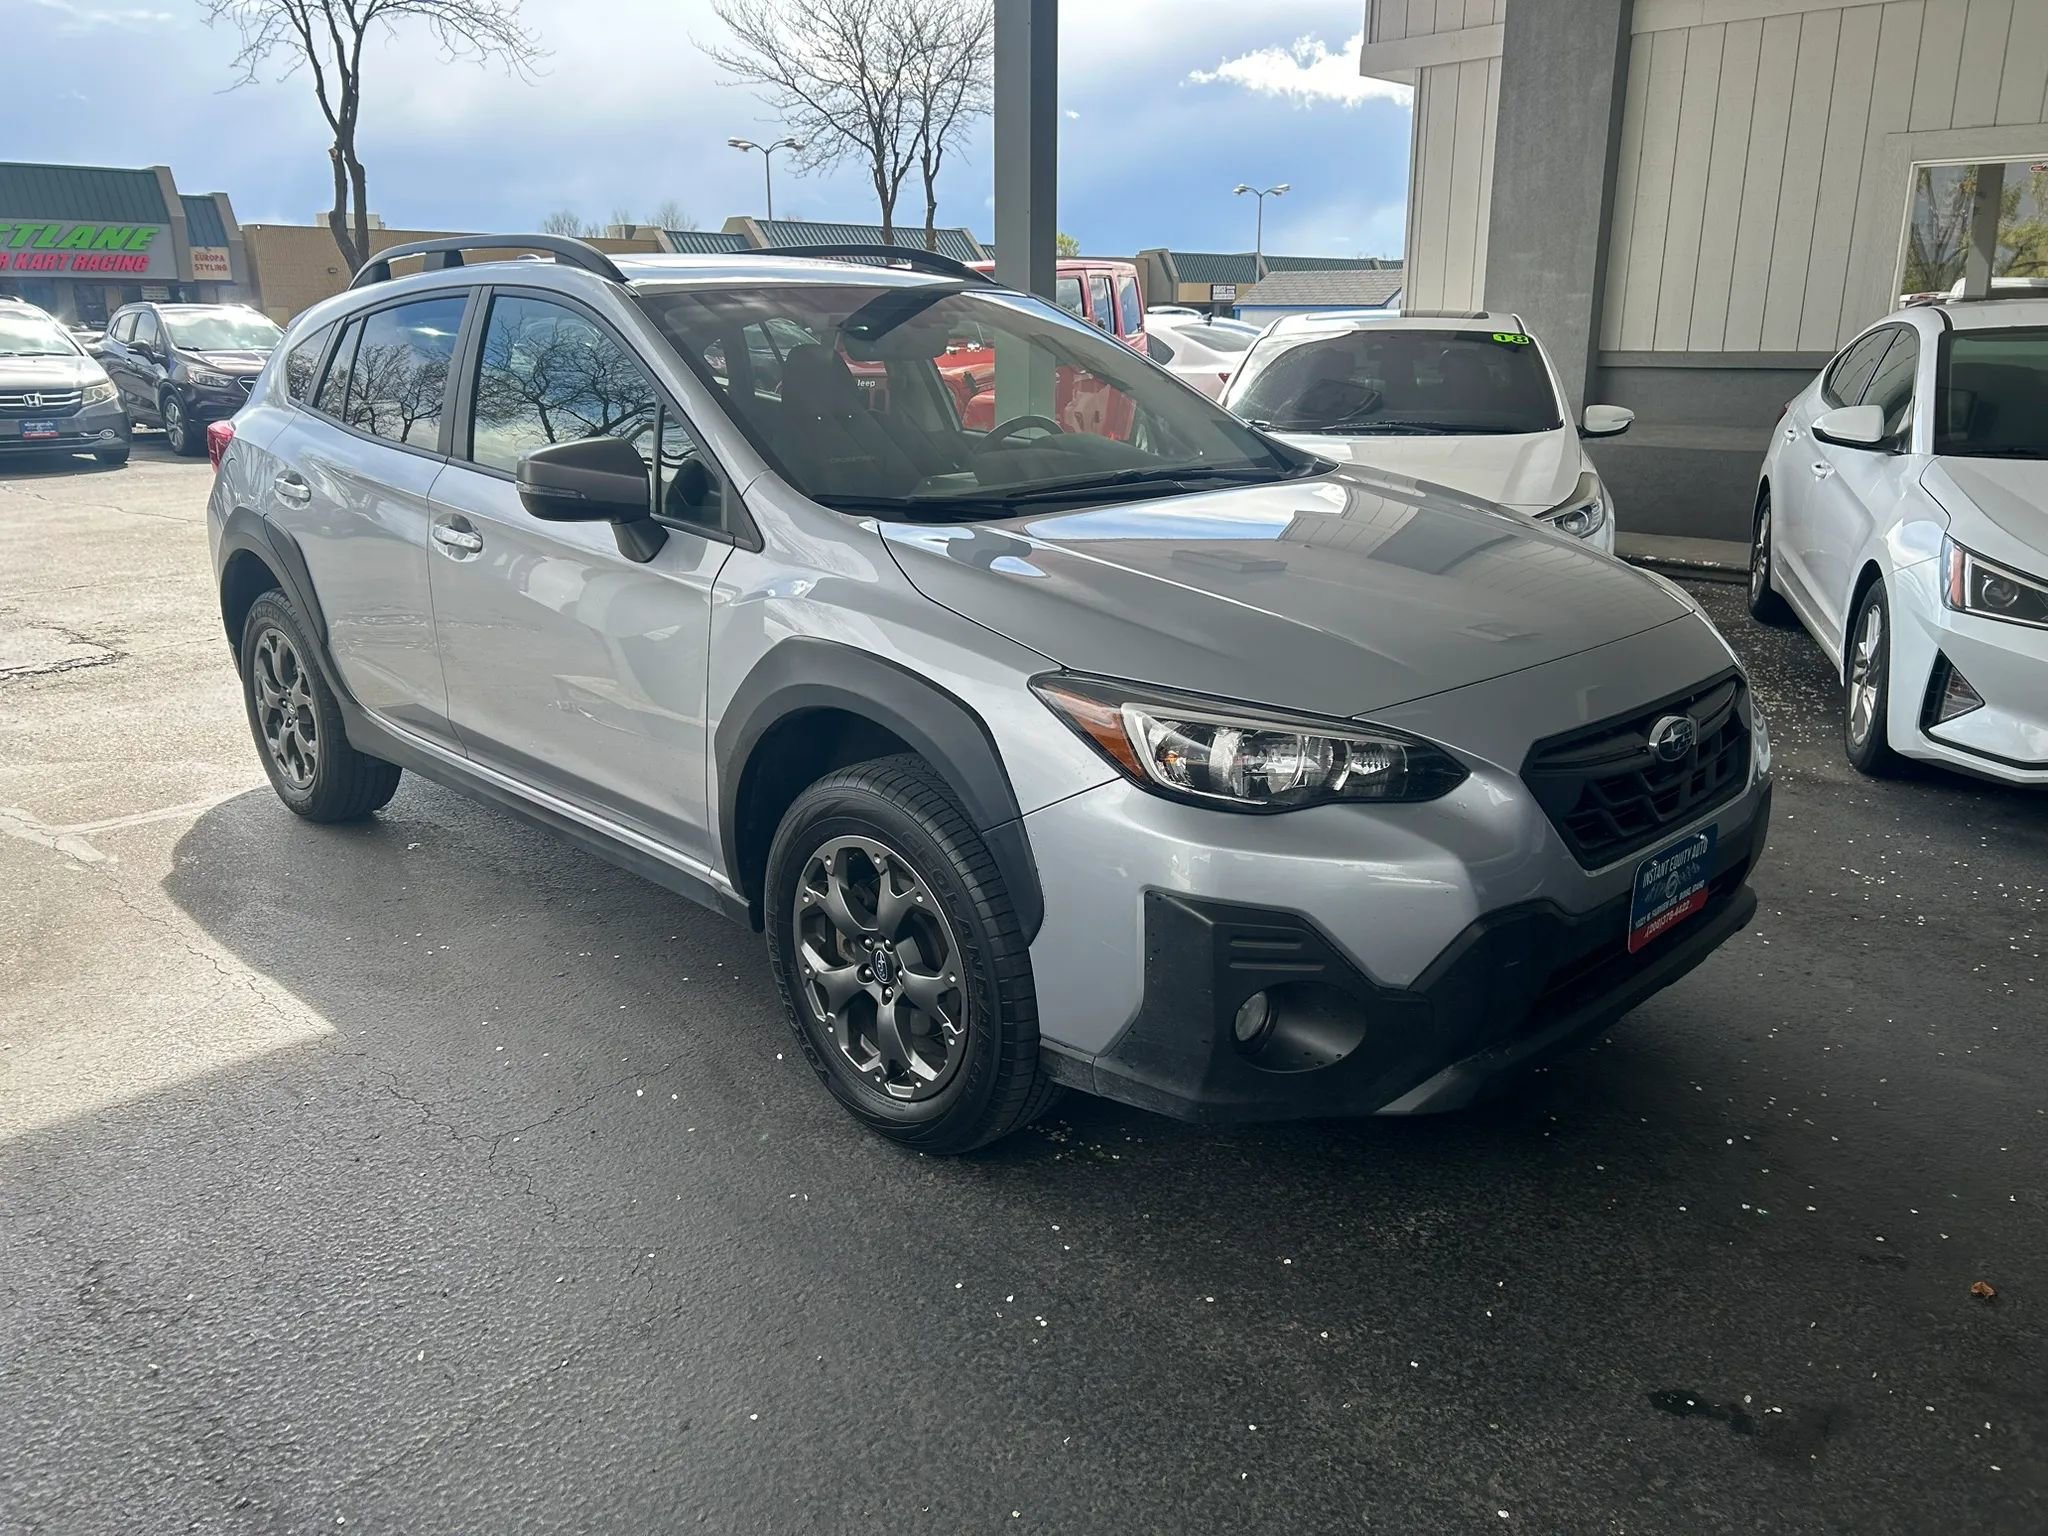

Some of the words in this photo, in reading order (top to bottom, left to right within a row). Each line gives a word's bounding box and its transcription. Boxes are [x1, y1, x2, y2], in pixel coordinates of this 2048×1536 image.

[13, 252, 71, 271] KART
[71, 254, 150, 272] RACING
[194, 254, 225, 262] EUROPA
[194, 263, 228, 272] STYLING
[857, 379, 876, 388] Jeep
[1643, 859, 1670, 888] INSTANT
[1669, 847, 1692, 872] EQUITY
[1691, 837, 1708, 860] AUTO
